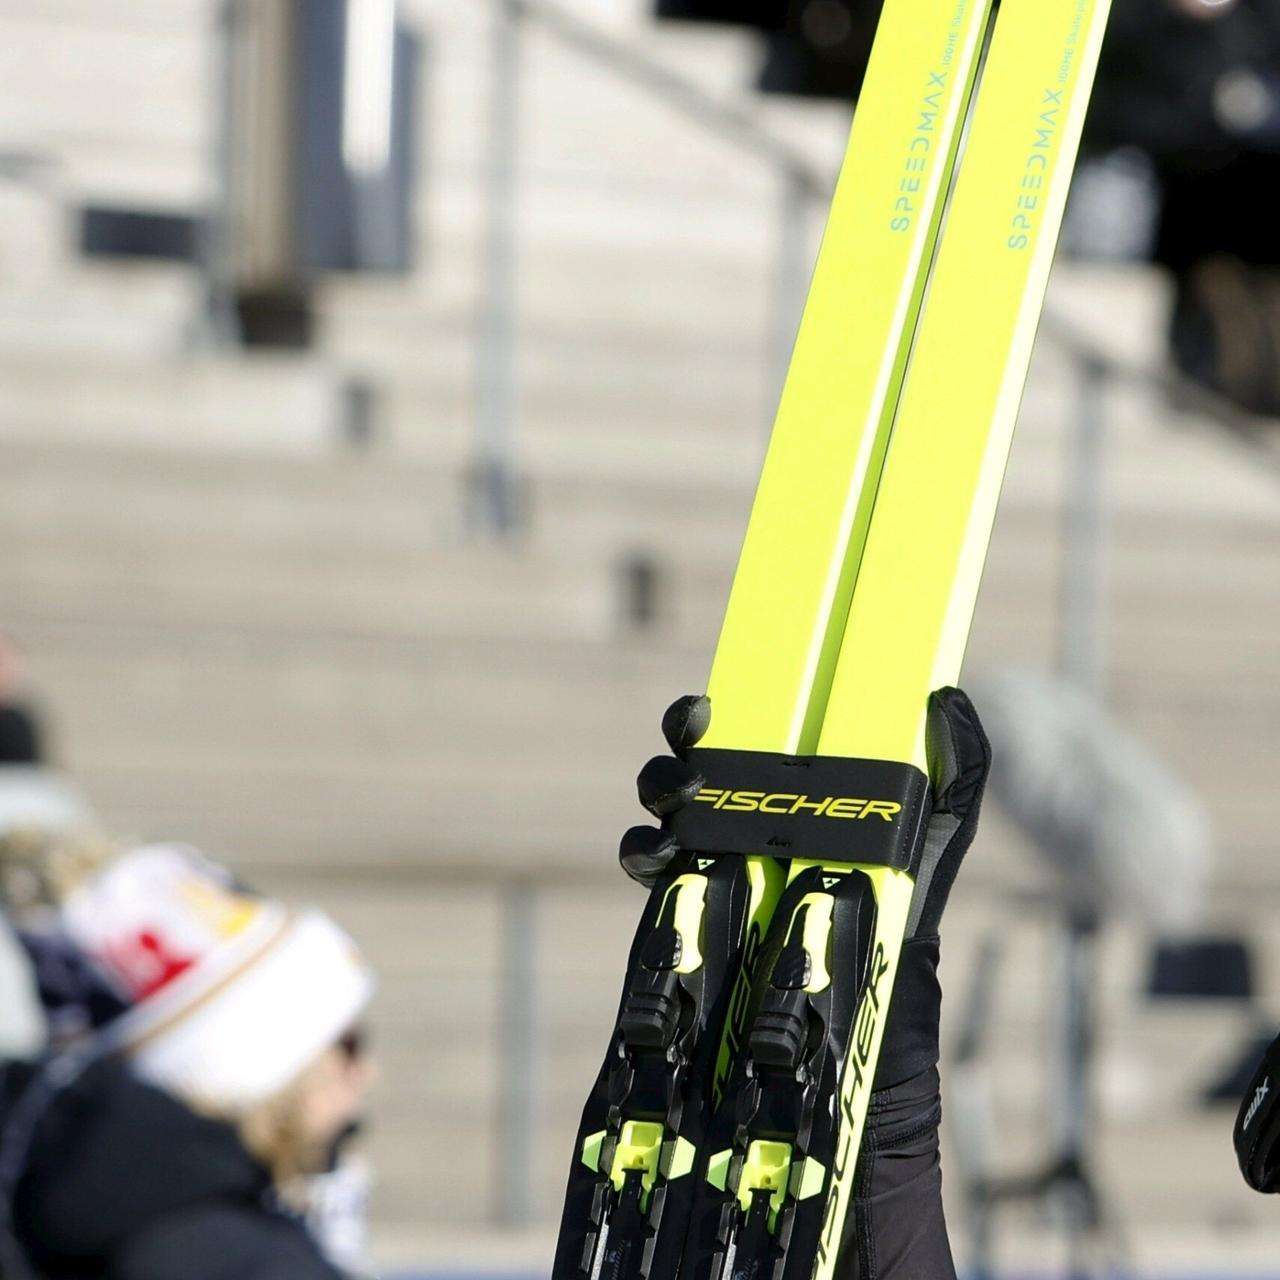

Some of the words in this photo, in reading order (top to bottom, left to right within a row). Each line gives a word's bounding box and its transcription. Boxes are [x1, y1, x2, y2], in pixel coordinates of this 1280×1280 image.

[890, 71, 948, 232] SPEEDMAX
[1007, 88, 1064, 250] SPEEDMAX
[692, 788, 902, 823] FISCHER
